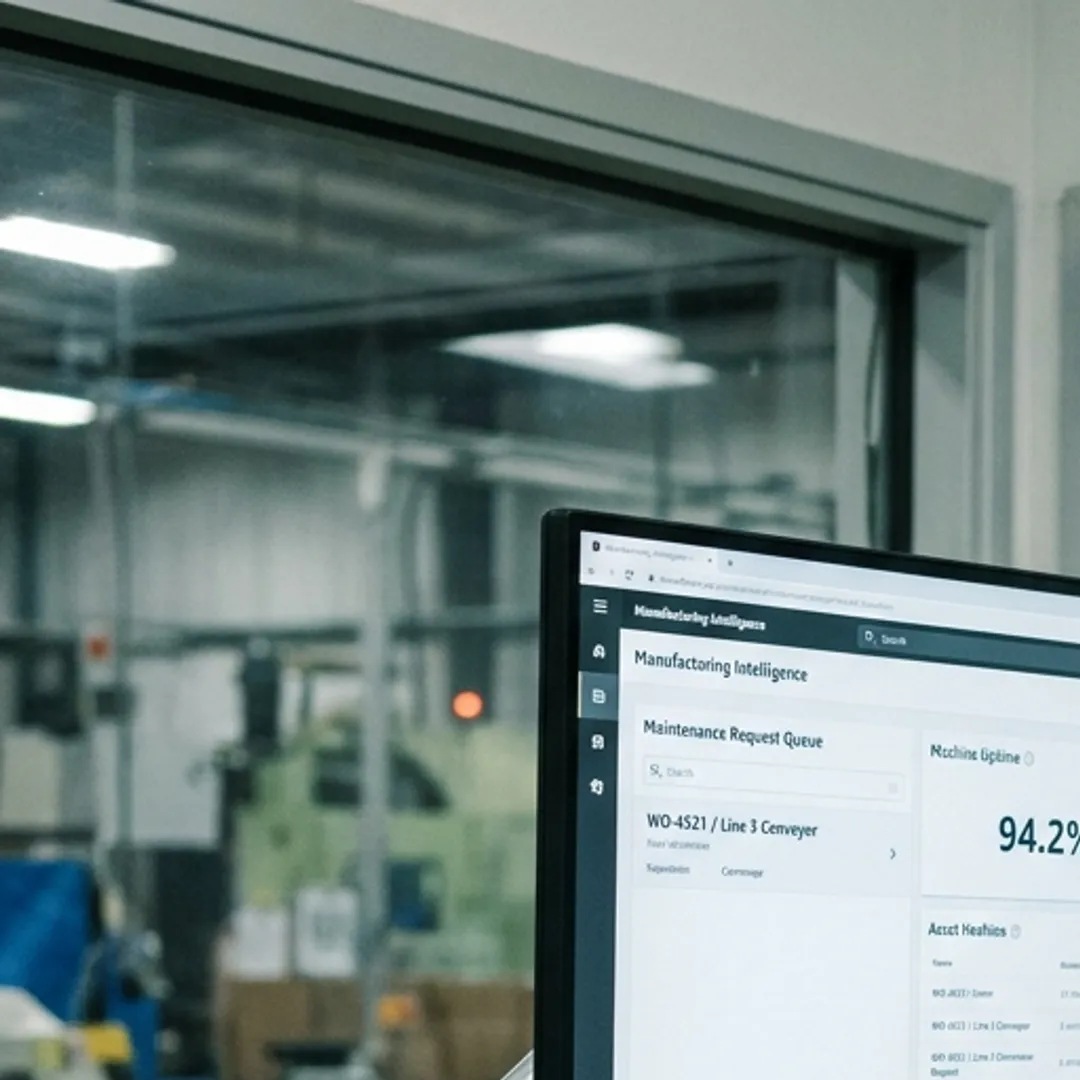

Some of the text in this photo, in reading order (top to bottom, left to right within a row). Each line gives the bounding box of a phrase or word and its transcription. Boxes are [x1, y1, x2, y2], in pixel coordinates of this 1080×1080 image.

[643, 719, 726, 741] Maintenance
[730, 726, 780, 747] Request
[721, 818, 747, 833] Line
[750, 819, 757, 834] 3
